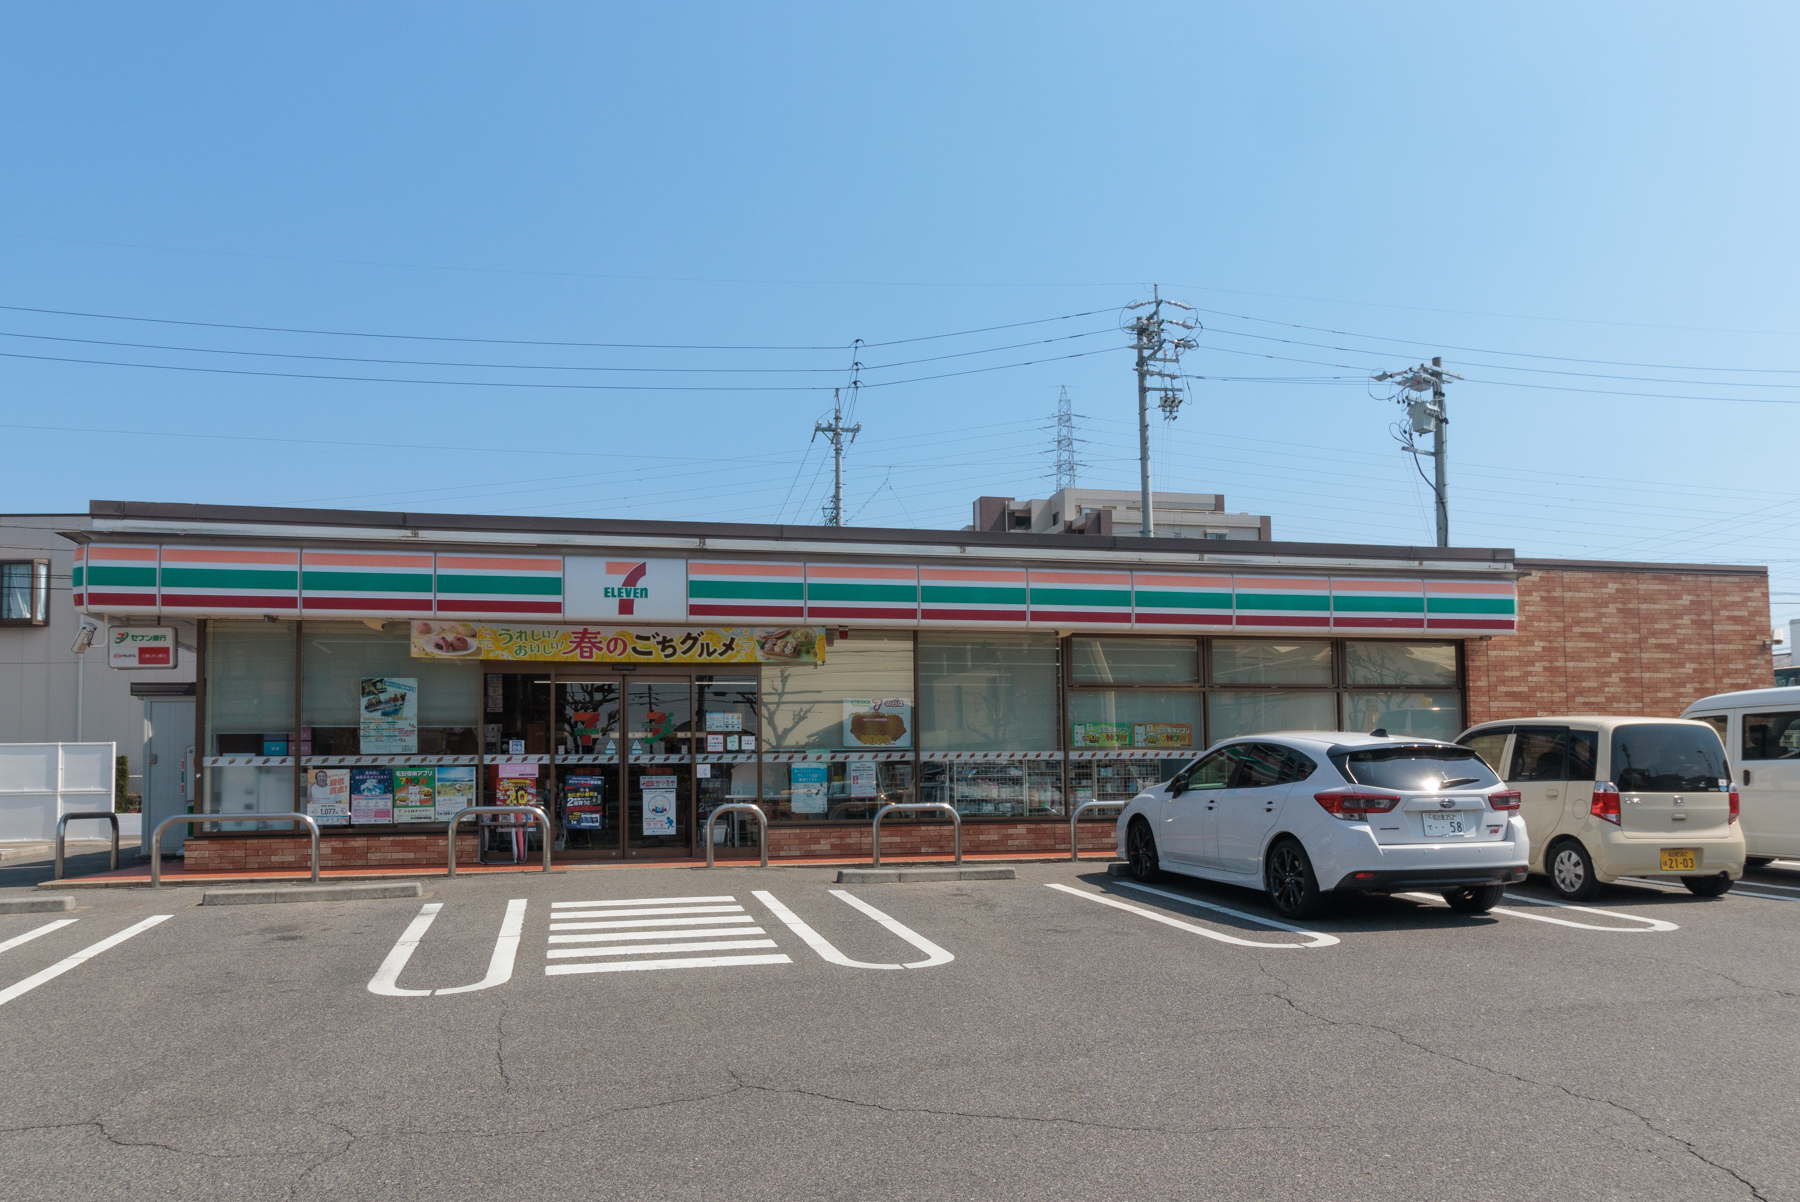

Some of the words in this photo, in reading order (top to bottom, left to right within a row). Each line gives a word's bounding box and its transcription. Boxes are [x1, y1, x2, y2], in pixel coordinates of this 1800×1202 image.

[131, 634, 167, 642] セブン銀行
[561, 627, 736, 660] 春のごちグルメ
[329, 777, 345, 787] 最低
[400, 777, 429, 785] 7NOW
[1668, 858, 1695, 869] 21-03
